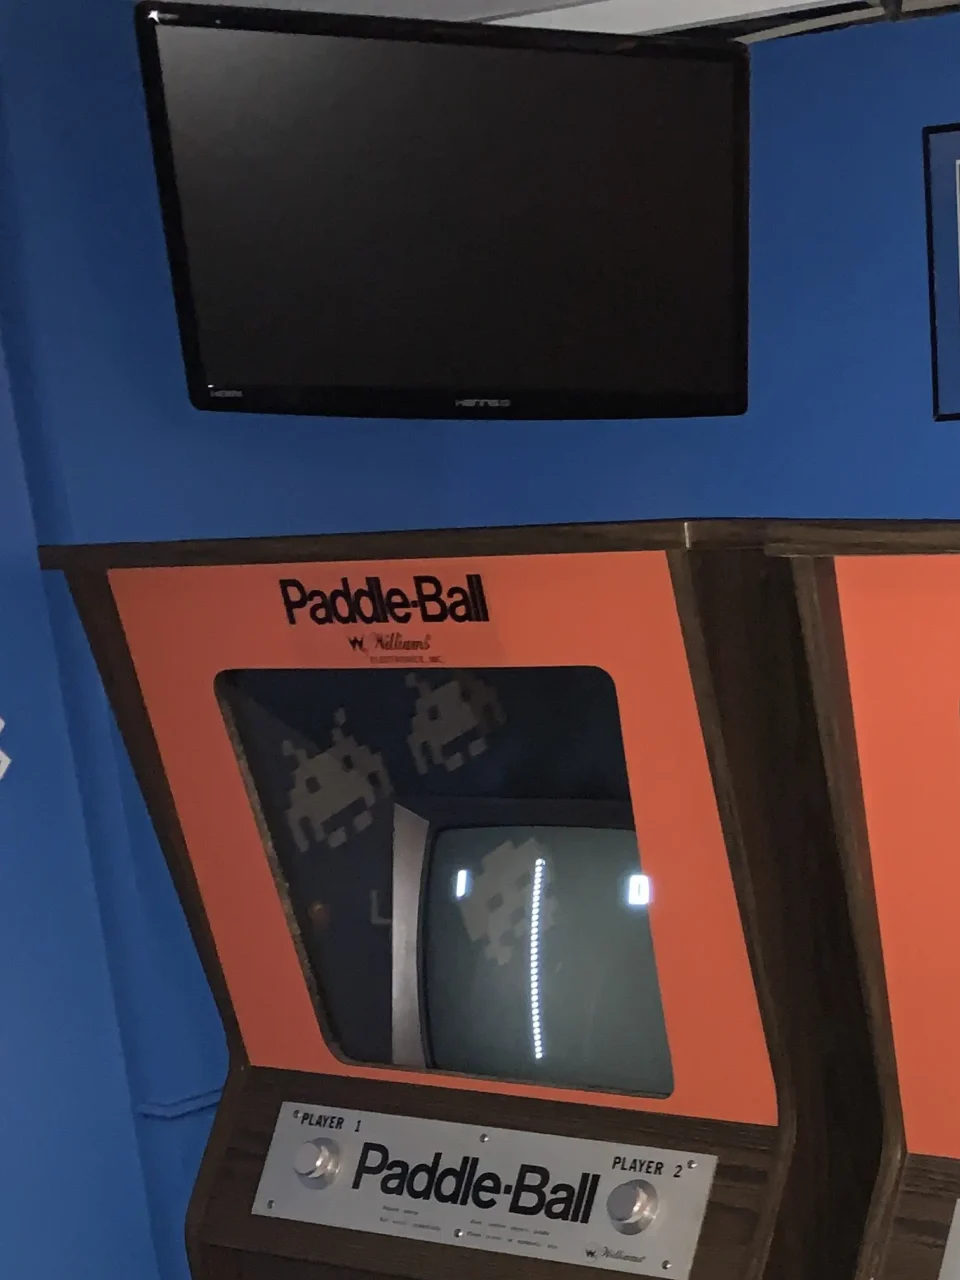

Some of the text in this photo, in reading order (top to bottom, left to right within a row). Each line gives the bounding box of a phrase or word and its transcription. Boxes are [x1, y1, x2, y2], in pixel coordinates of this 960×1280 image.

[279, 574, 489, 625] Paddle-Ball
[301, 1113, 361, 1132] PLAYER 1
[351, 1142, 601, 1224] Paddle-Ball
[612, 1156, 682, 1178] PLAYER 2
